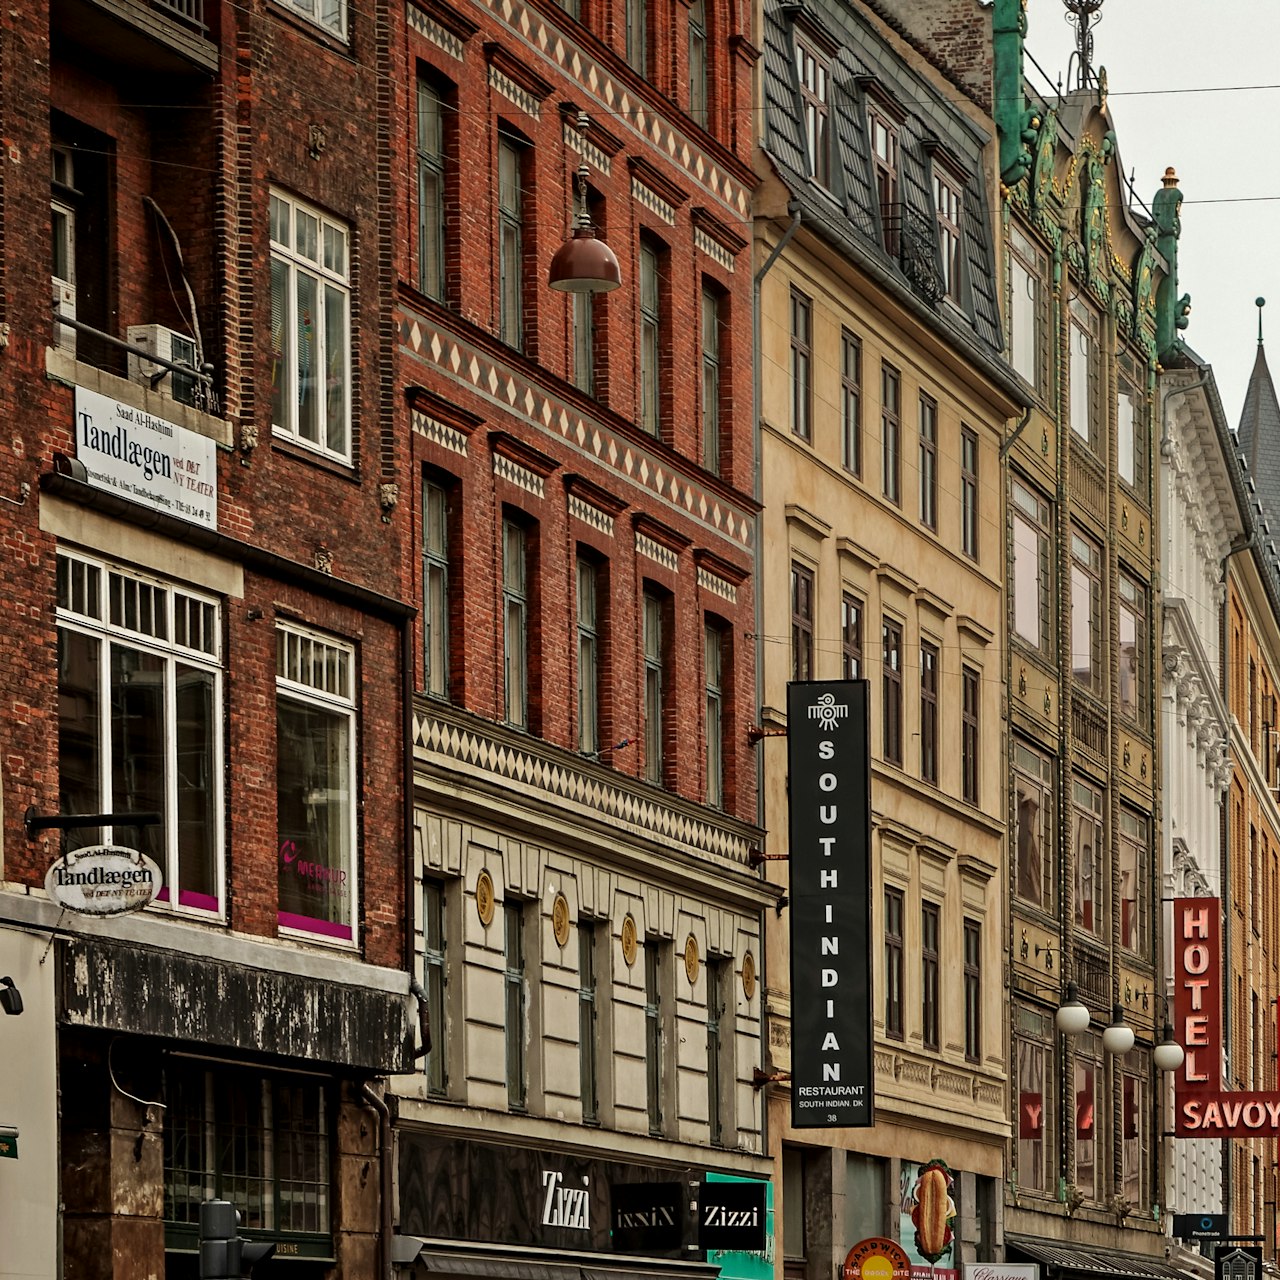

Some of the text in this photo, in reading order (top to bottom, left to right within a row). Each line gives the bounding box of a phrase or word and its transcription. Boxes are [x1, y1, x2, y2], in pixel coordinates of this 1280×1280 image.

[116, 403, 173, 438] Saad Al-Hashimi
[78, 411, 172, 481] Tandlægen
[186, 477, 214, 498] TEATER
[52, 867, 153, 889] Tandlægen
[1183, 907, 1210, 1082] HOTEL
[798, 1086, 865, 1096] RESTAURANT
[827, 1114, 837, 1122] 38
[542, 1170, 591, 1230] Zizzi
[704, 1206, 759, 1227] Zizzi
[276, 1244, 298, 1254] UISINE
[851, 1242, 904, 1270] SANDWICH
[845, 1268, 860, 1276] THE
